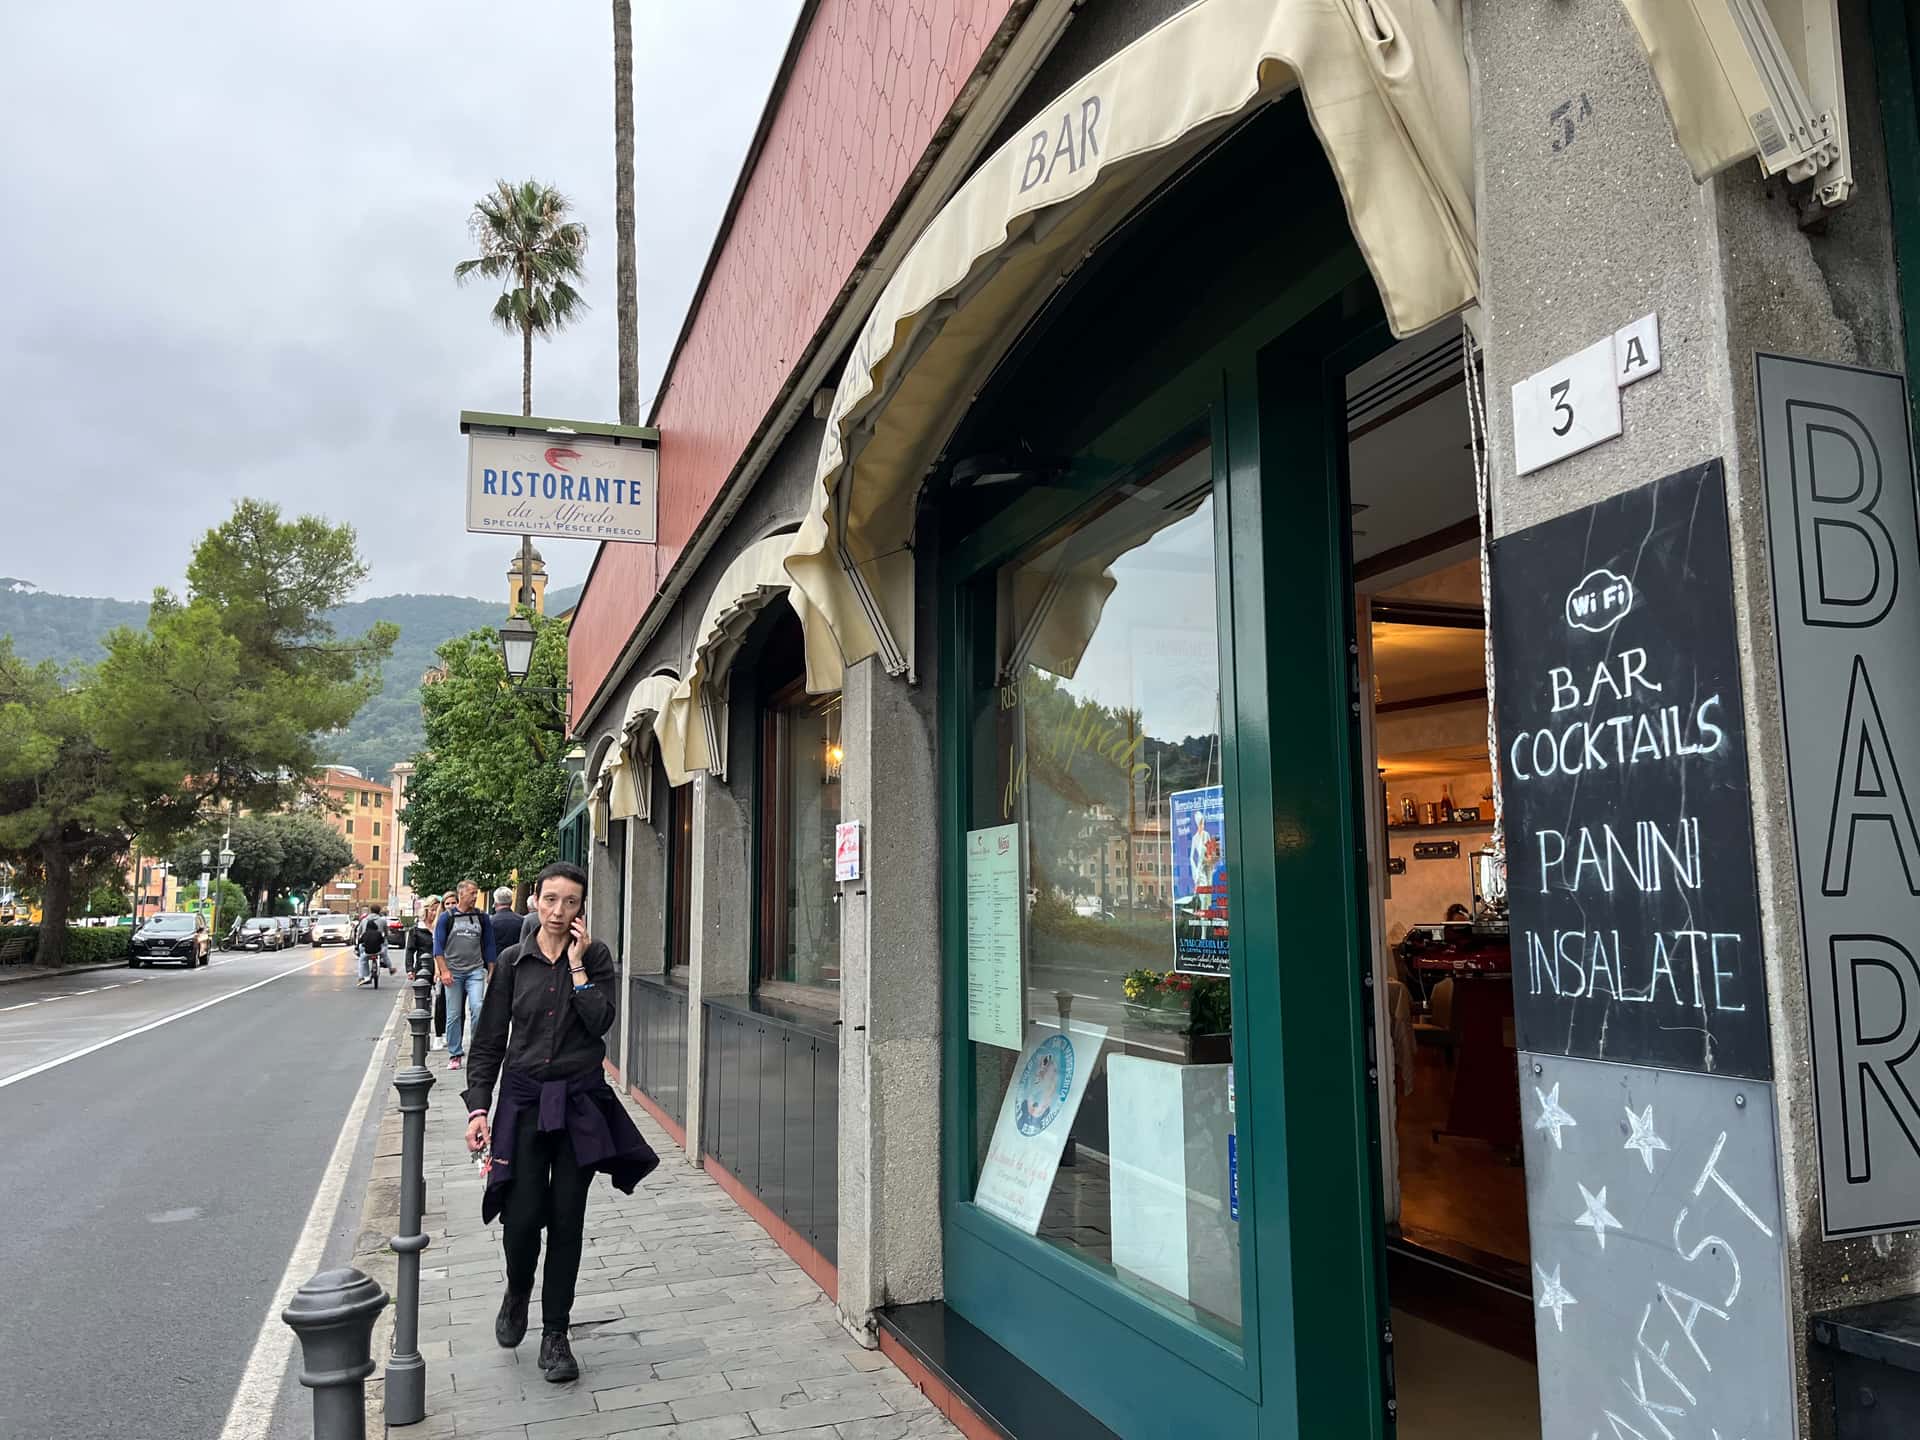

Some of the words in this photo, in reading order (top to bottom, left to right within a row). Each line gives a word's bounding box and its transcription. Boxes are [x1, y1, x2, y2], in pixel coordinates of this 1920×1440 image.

[1018, 95, 1101, 193] BAR
[1550, 378, 1574, 437] 3
[1623, 335, 1648, 374] A
[483, 468, 641, 506] RISTORANTE
[507, 500, 534, 518] da
[540, 502, 617, 526] Alfredo
[1548, 647, 1663, 713] BAR
[1510, 693, 1724, 781] COCKTAILS
[1786, 399, 1920, 1185] BAR
[1535, 817, 1701, 894] PANINI
[1525, 930, 1746, 1012] INSALATE
